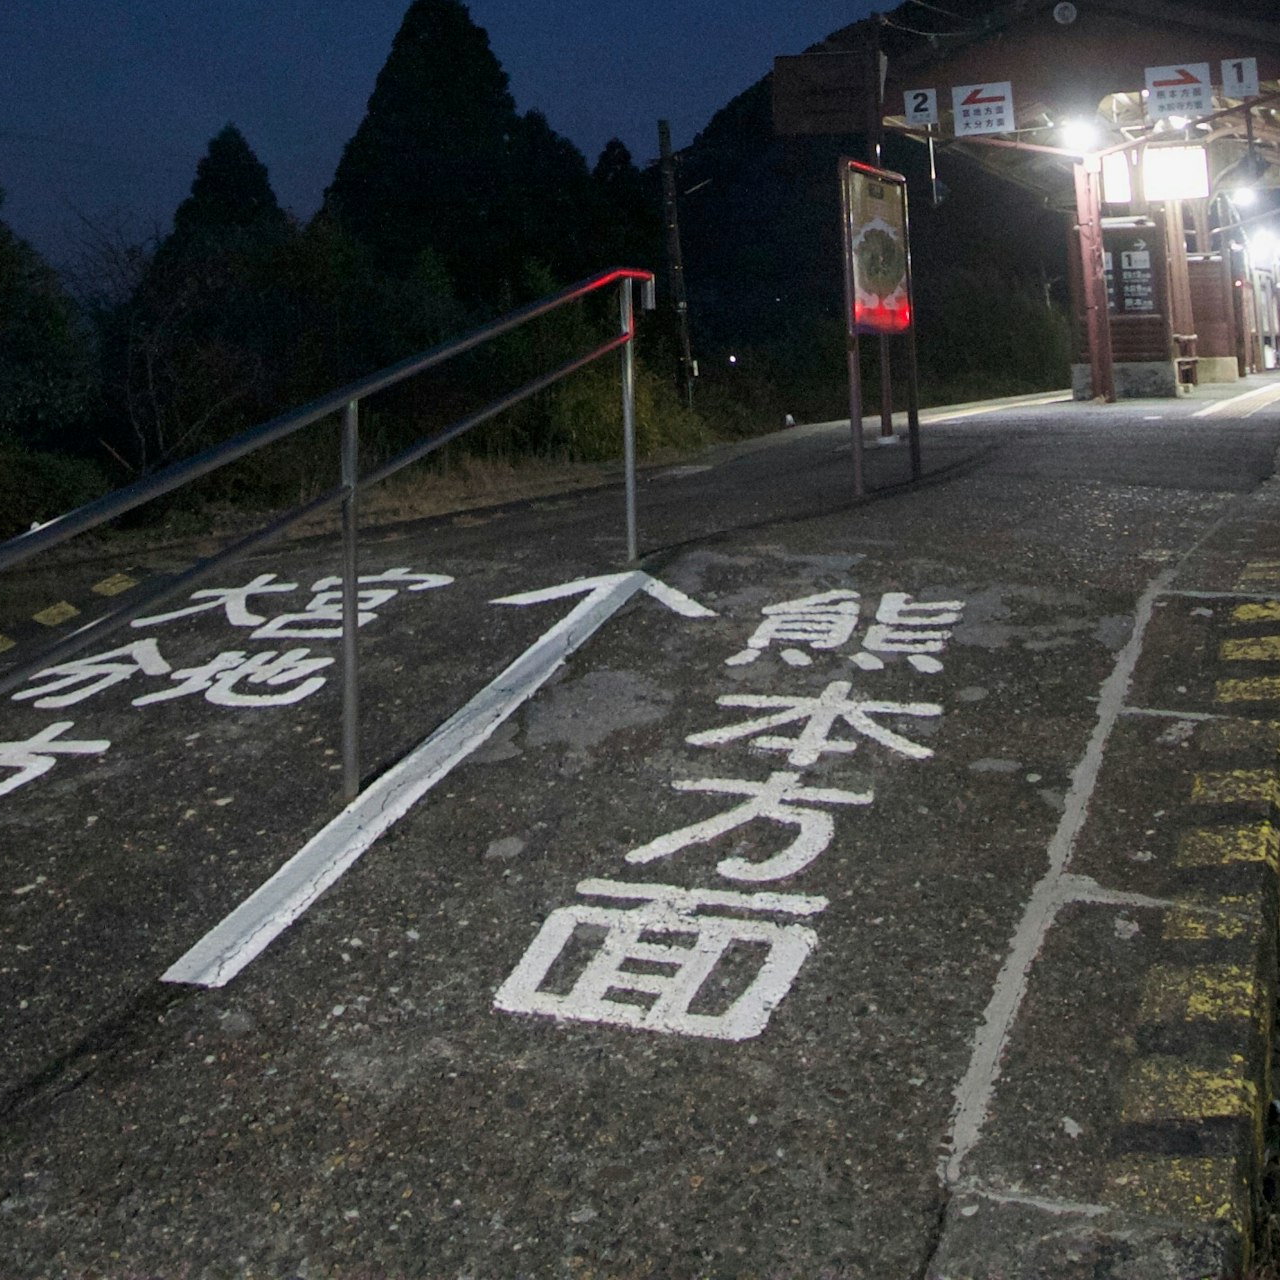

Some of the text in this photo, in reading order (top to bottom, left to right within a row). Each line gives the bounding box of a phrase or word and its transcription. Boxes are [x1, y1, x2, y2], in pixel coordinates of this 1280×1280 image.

[1232, 62, 1244, 84] 1
[913, 92, 929, 113] 2
[963, 117, 1006, 130] 大分方面
[1124, 254, 1133, 267] 1
[492, 588, 967, 1041] 熊本方面
